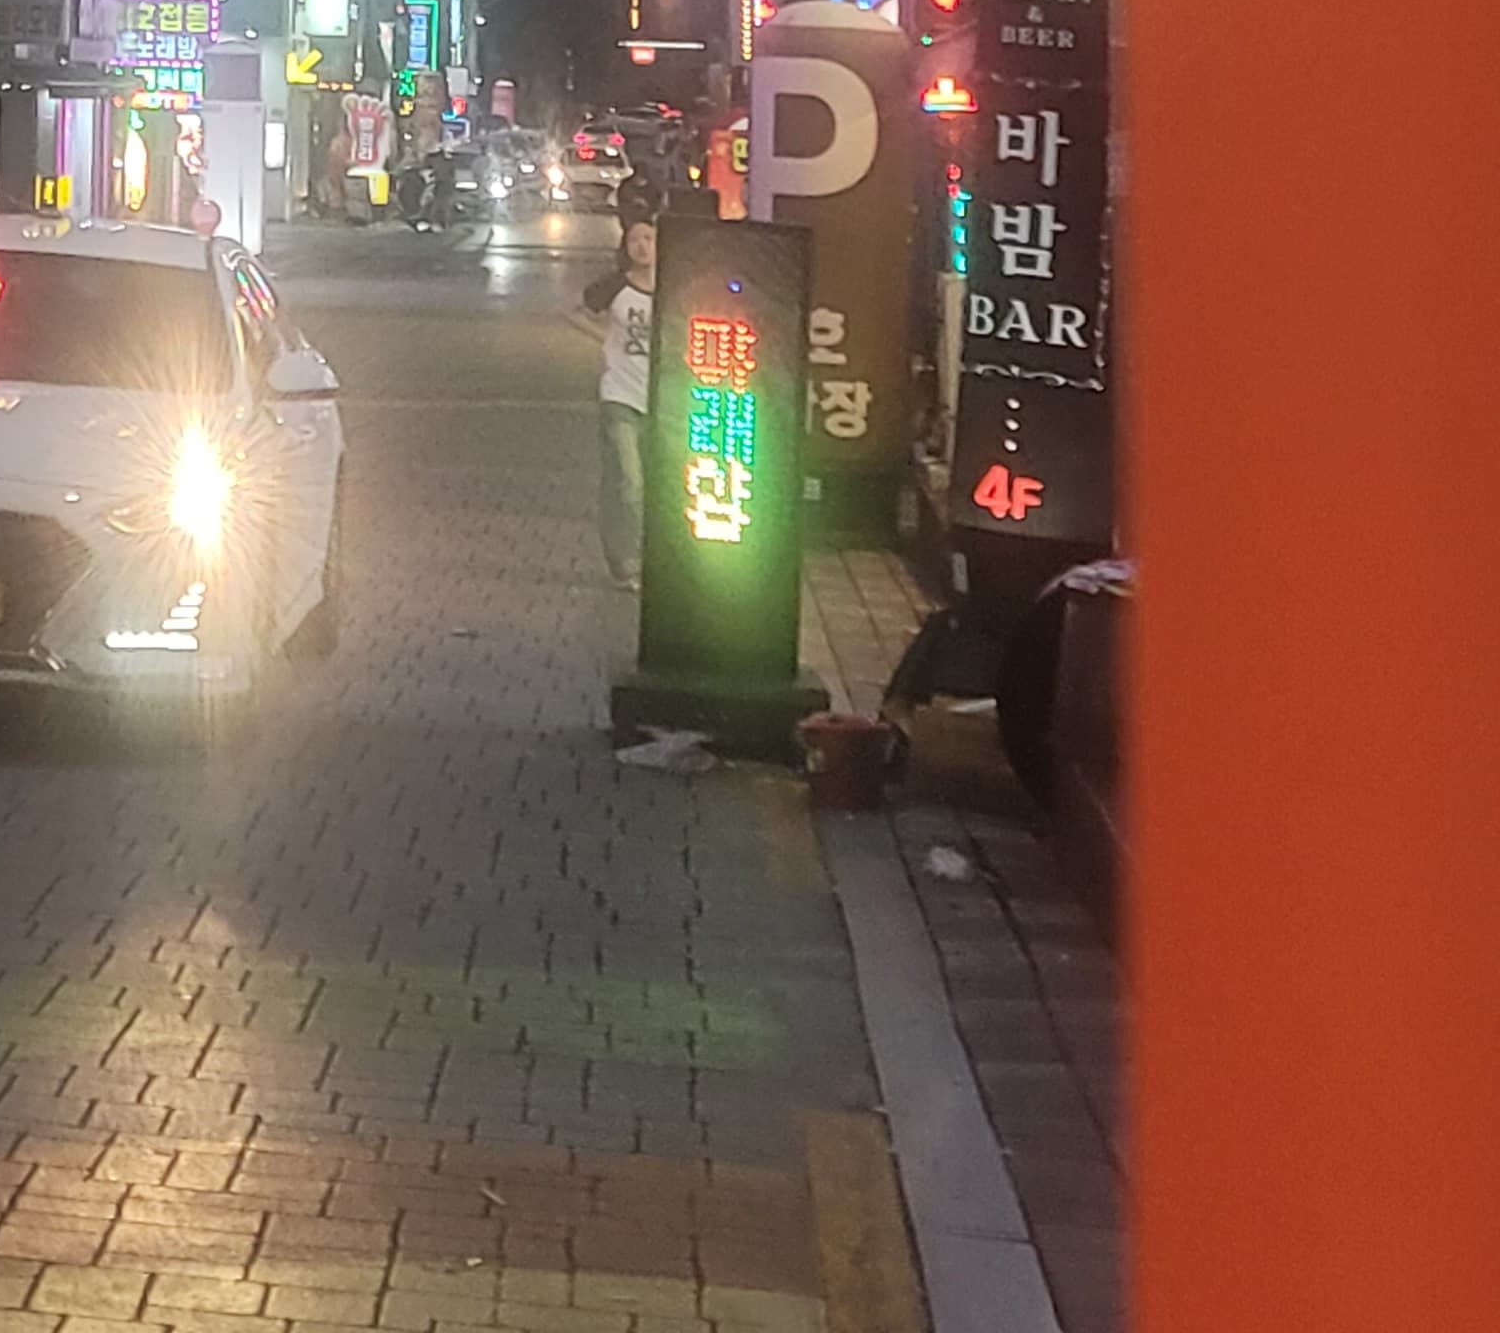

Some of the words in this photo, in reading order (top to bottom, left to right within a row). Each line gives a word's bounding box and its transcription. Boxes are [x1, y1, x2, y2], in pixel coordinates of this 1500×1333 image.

[1001, 27, 1077, 50] BEER
[749, 54, 879, 224] P
[990, 109, 1070, 279] 바밤
[966, 294, 1090, 349] BAR
[973, 463, 1045, 522] 4F
